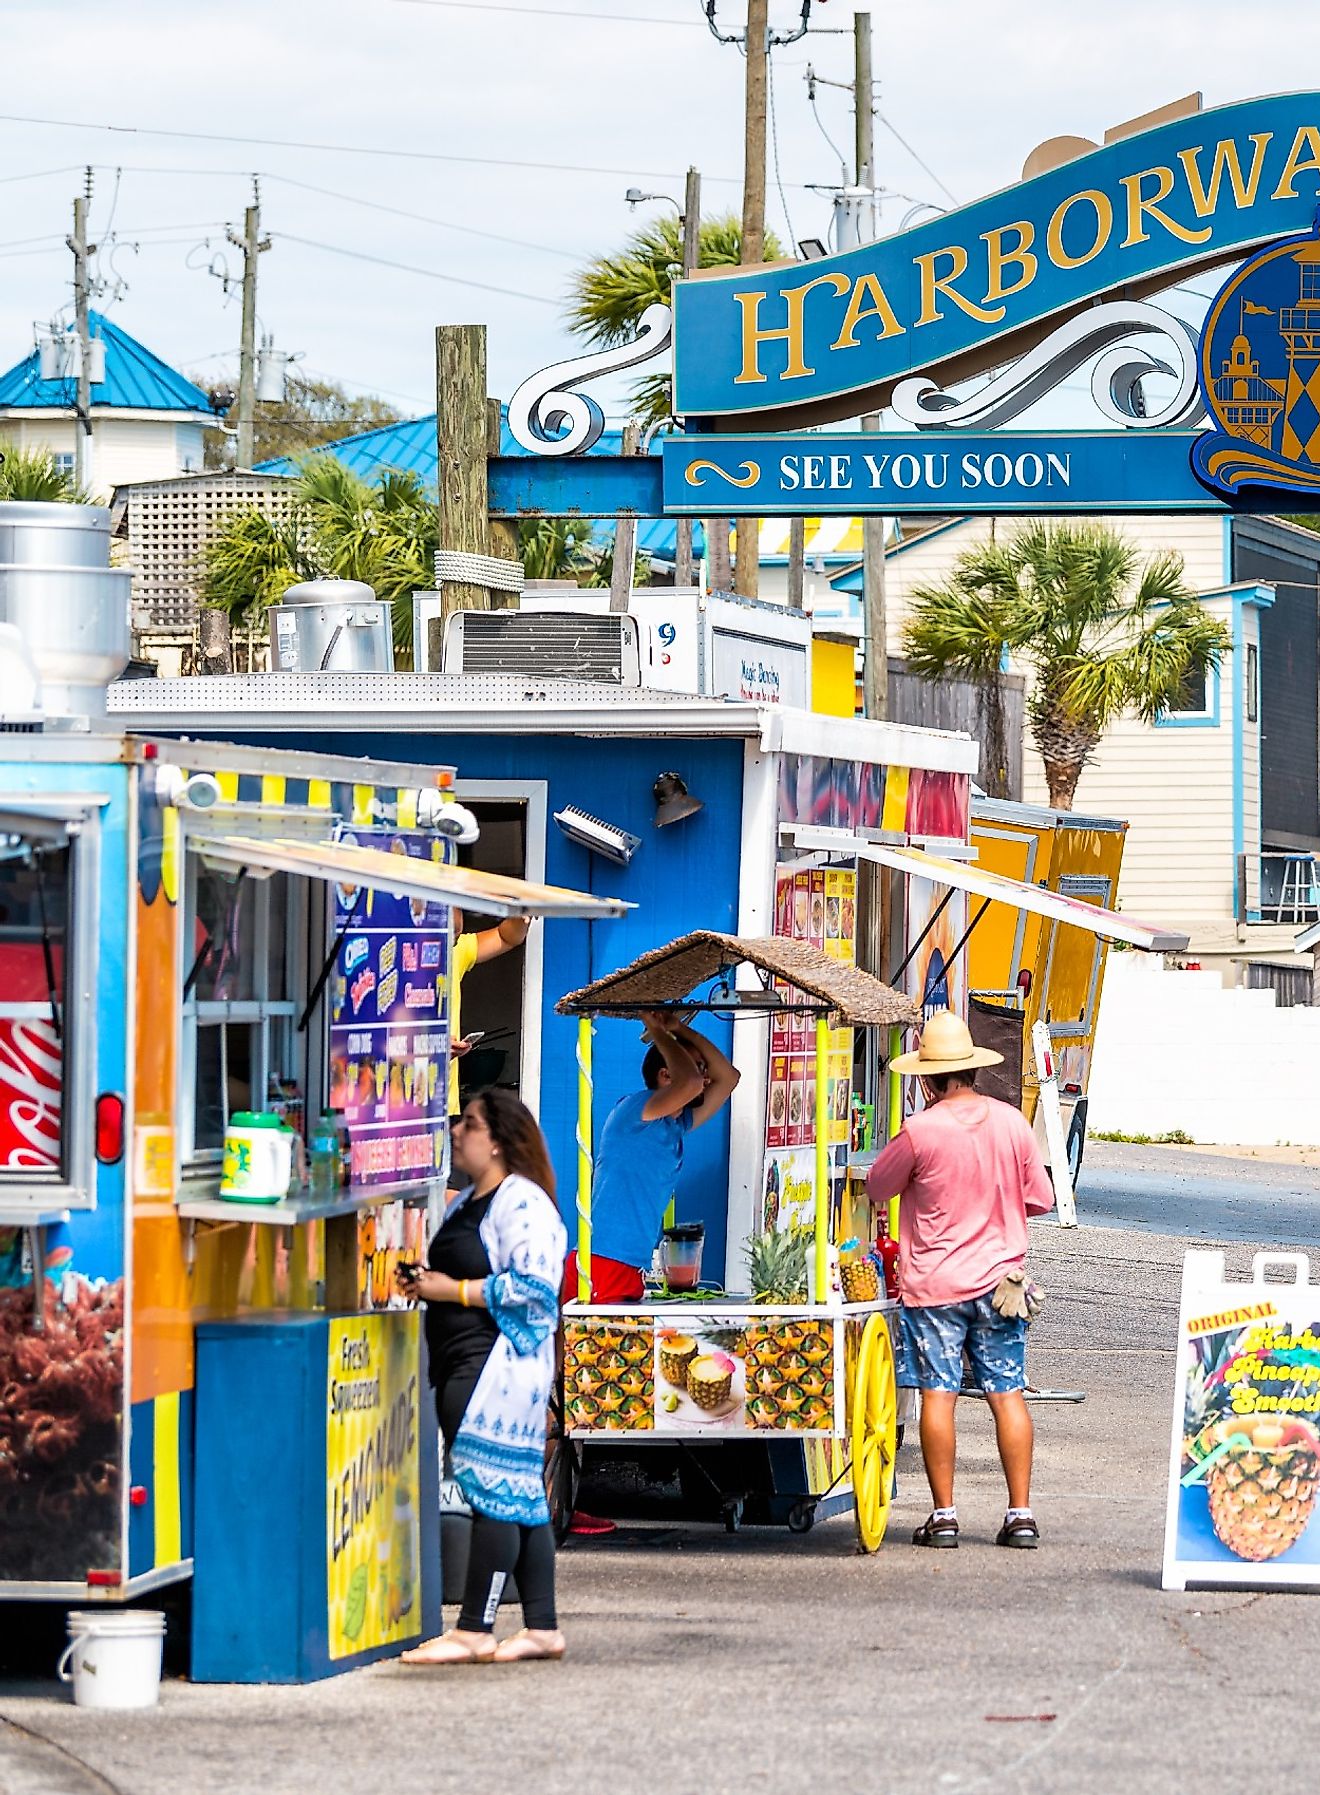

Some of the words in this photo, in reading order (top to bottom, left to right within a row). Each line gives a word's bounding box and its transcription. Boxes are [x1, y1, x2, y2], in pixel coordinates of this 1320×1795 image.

[779, 454, 853, 491] SEE
[860, 453, 955, 490] YOU
[960, 452, 1072, 489] SOON
[1187, 1301, 1278, 1334] ORIGINAL
[341, 1329, 370, 1372] Fresh
[330, 1368, 380, 1426] Squeezed
[332, 1374, 417, 1563] LEMONADE
